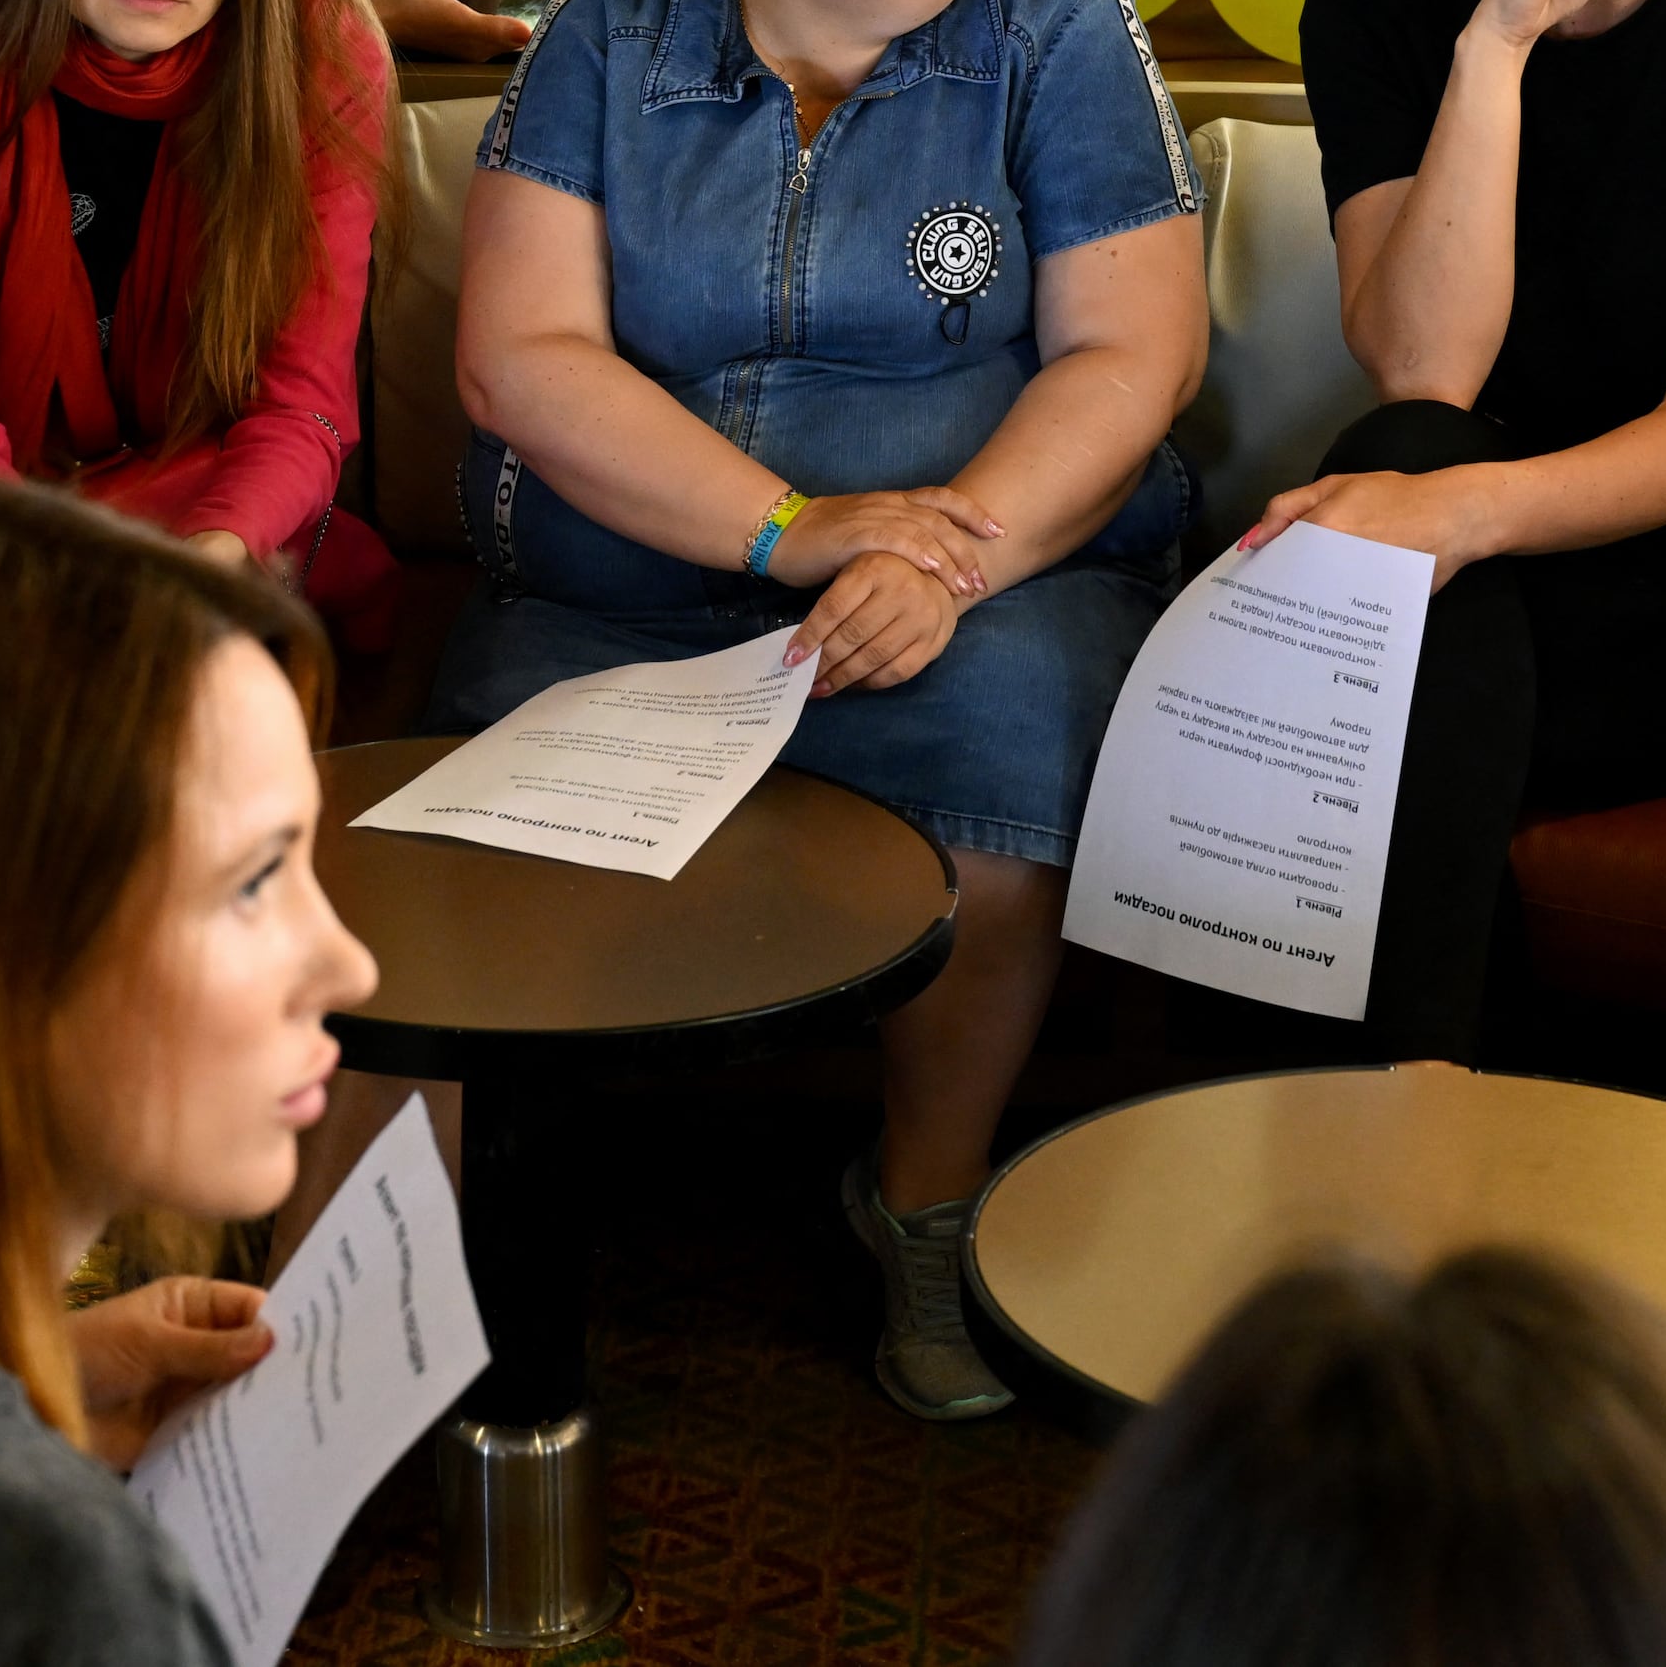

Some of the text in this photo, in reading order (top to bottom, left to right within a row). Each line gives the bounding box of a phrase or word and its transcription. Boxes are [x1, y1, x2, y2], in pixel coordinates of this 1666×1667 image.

[922, 218, 959, 262] CLUNG
[1231, 600, 1386, 651] здійснювати посадку (людей та
[1237, 584, 1388, 634] автомобілей) під керівництвом
[1349, 597, 1392, 616] парому.
[1209, 612, 1375, 668] контролювати посадкові талони та
[1333, 673, 1379, 693] Рівень 3
[1155, 701, 1365, 771] очікування на посадку чи висадку та чергу
[1158, 685, 1369, 753] для автомобілей які заїзджають на паркінг
[1330, 718, 1371, 737] парому
[1179, 729, 1355, 788] при необхідності формувати черги
[424, 807, 659, 847] Агент по контролю посадки
[1313, 793, 1359, 813] Рівень 2
[1169, 815, 1342, 871] направляти пасажирів до пунктів
[1180, 842, 1338, 894] проводити огляд автомобілей
[1297, 835, 1352, 856] контролю
[1114, 891, 1335, 967] Агент по контролю посадки
[1296, 898, 1343, 918] Рівень 1
